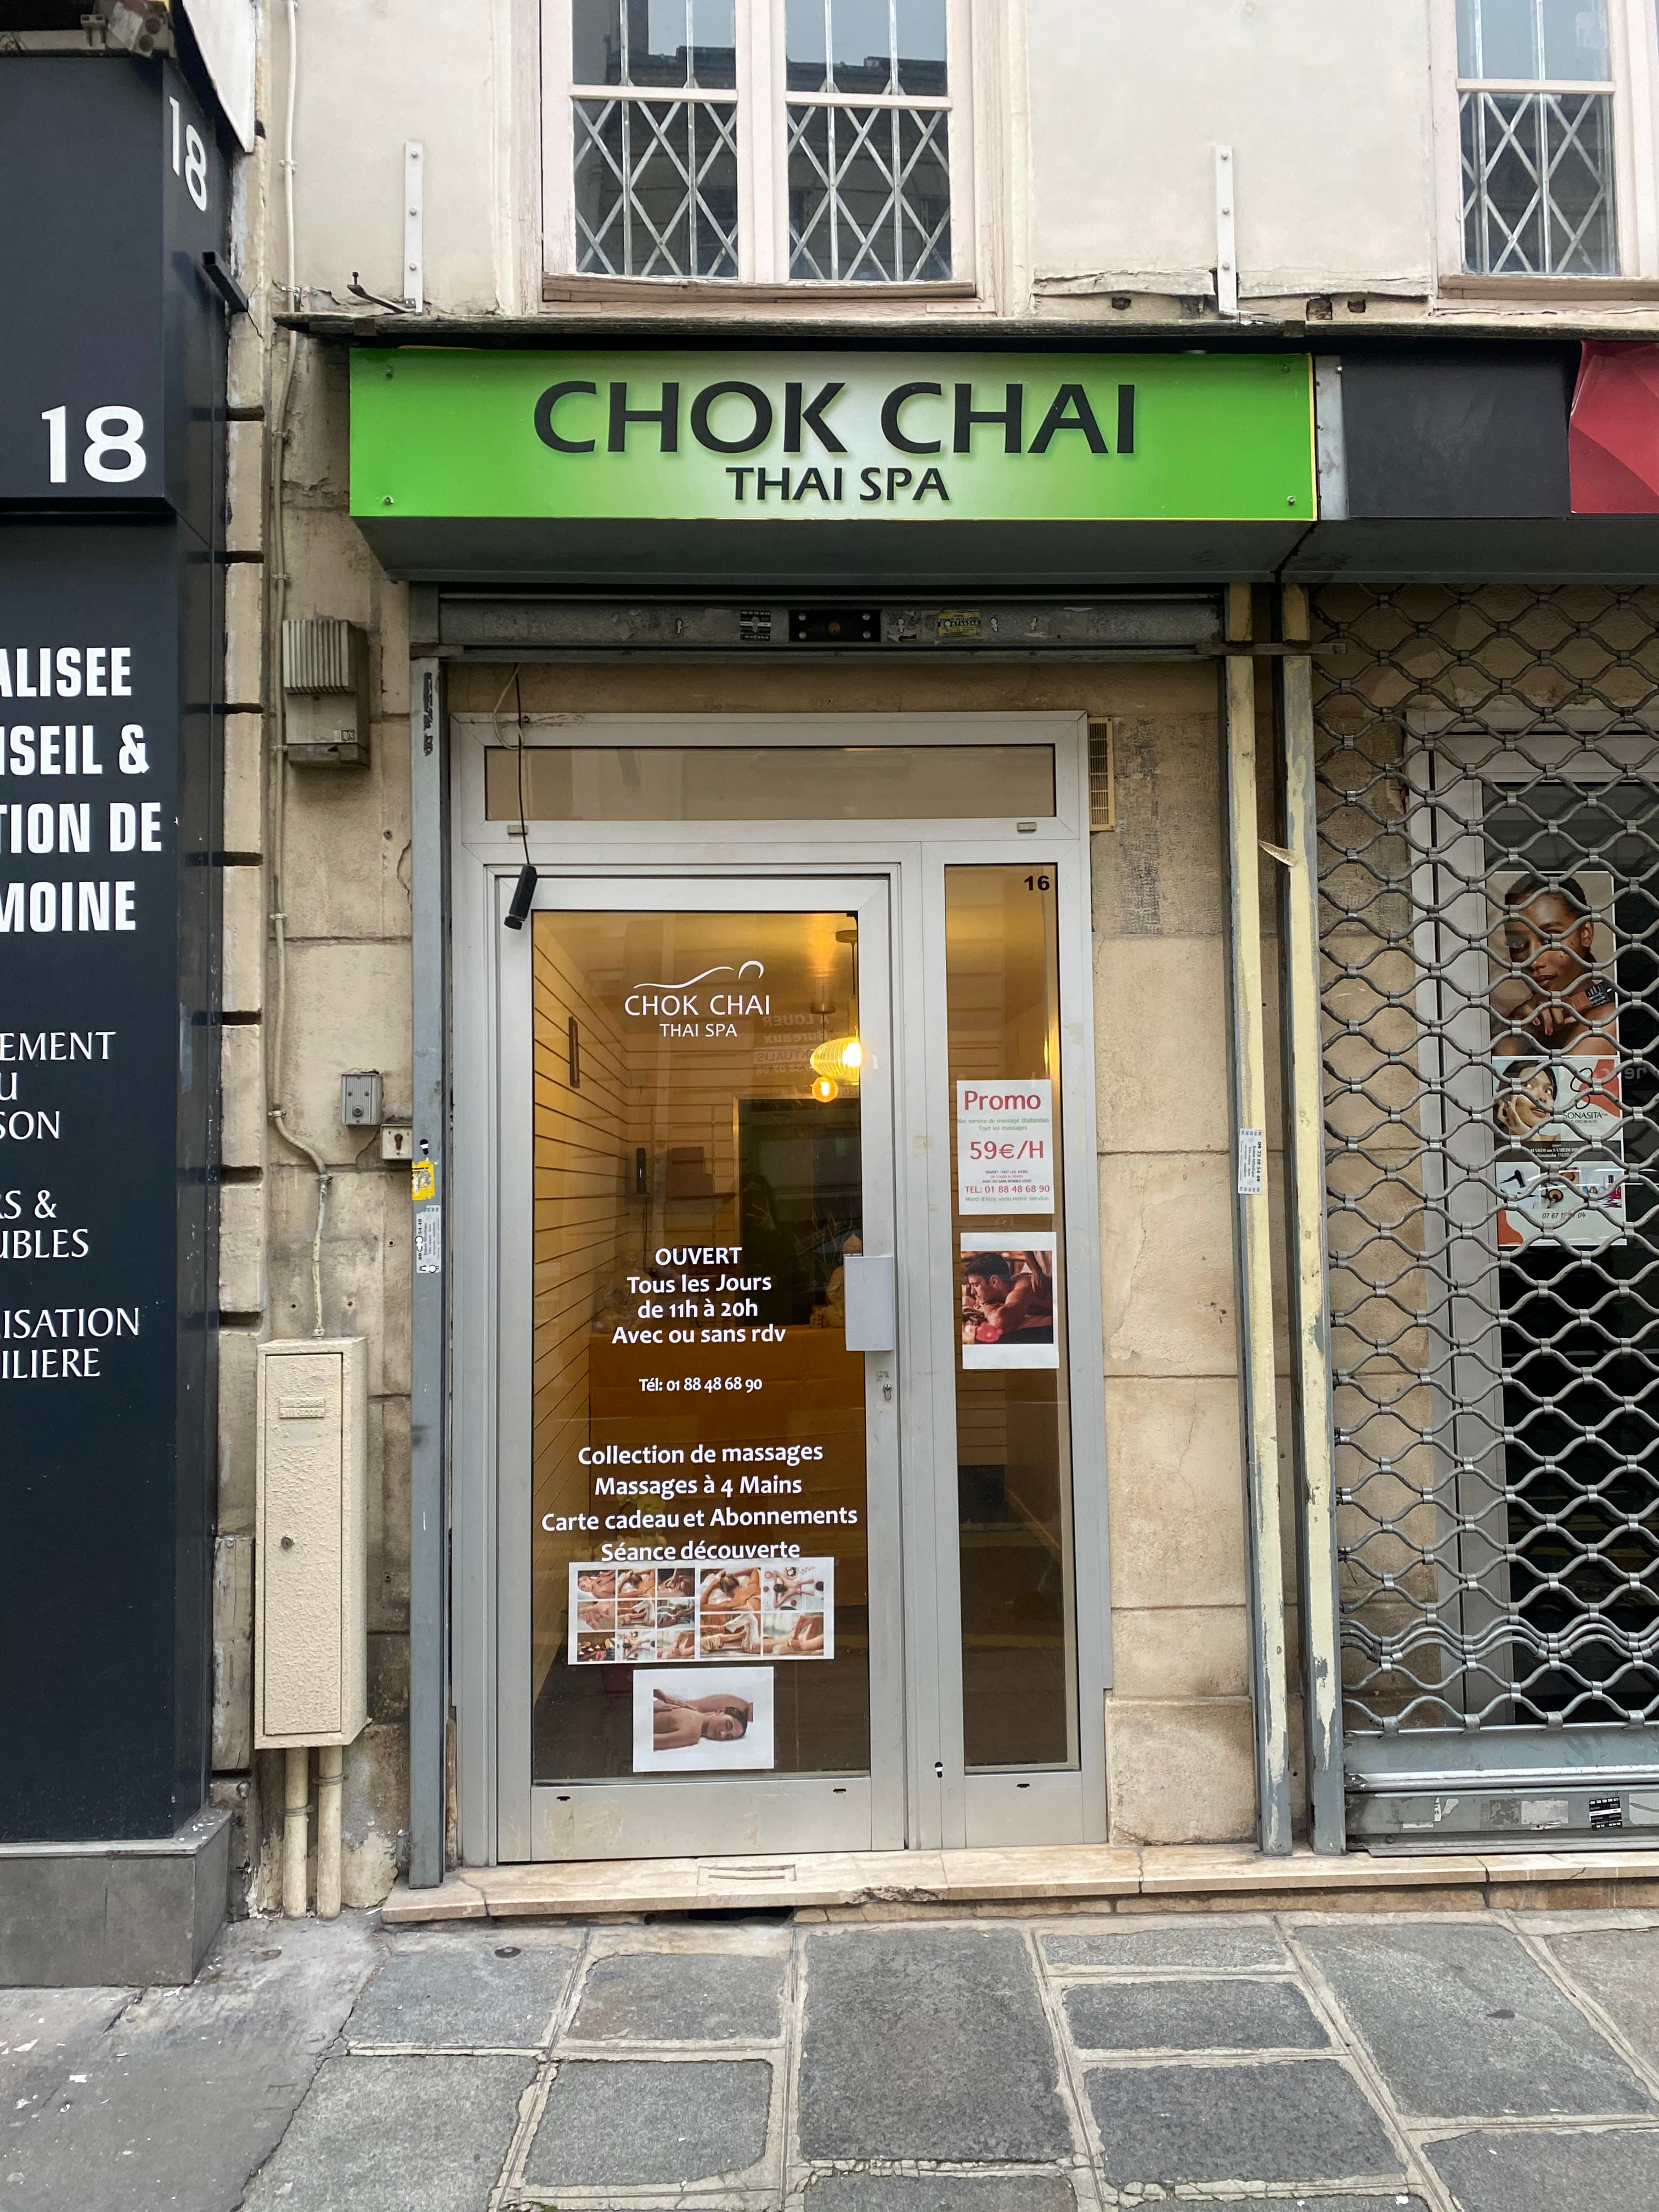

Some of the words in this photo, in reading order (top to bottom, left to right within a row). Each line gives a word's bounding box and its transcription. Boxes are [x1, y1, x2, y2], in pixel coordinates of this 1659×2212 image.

[169, 97, 208, 212] 18
[534, 381, 848, 453] CHOK
[880, 382, 1135, 454] CHAI
[41, 405, 146, 483] 18
[725, 467, 842, 500] THAI
[859, 467, 950, 501] SPA
[0, 725, 103, 776] SEIL
[119, 724, 150, 774] &
[110, 802, 162, 852] DE
[1024, 876, 1050, 891] 16
[0, 881, 136, 933] MOINE
[624, 995, 699, 1015] CHOK
[710, 994, 769, 1015] CHAI
[659, 1023, 698, 1037] THAI
[706, 1023, 737, 1037] SPA
[0, 1031, 116, 1061] EMENT
[965, 1091, 1041, 1110] Promo
[970, 1141, 1043, 1160] 59€/H
[34, 1189, 57, 1218] &
[655, 1247, 742, 1265] OUVERT
[627, 1276, 675, 1294] Tous
[682, 1274, 710, 1293] les
[715, 1273, 772, 1291] Jours
[637, 1300, 663, 1319] de
[668, 1300, 698, 1318] 11h
[704, 1300, 715, 1317] à
[721, 1299, 758, 1317] 20h
[0, 1307, 139, 1339] ISATION
[611, 1327, 663, 1344] Avec
[668, 1329, 695, 1343] ou
[701, 1328, 746, 1342] sans
[751, 1324, 786, 1342] rdv
[2, 1348, 100, 1379] ILIERE
[639, 1378, 663, 1392] Tél:
[666, 1380, 680, 1391] 01
[684, 1378, 702, 1391] 88
[704, 1378, 722, 1393] 48
[724, 1376, 742, 1390] 68
[745, 1378, 762, 1393] 90
[578, 1445, 685, 1465] Collection
[690, 1444, 716, 1463] de
[721, 1444, 823, 1467] massages
[595, 1477, 698, 1500] Massages
[703, 1475, 716, 1494] à
[720, 1479, 733, 1498] 4
[740, 1475, 802, 1493] Mains
[541, 1513, 599, 1532] Carte
[605, 1510, 679, 1531] cadeau
[686, 1511, 705, 1527] et
[710, 1506, 858, 1526] Abonnements
[601, 1542, 676, 1561] Séance
[680, 1541, 800, 1560] découverte
